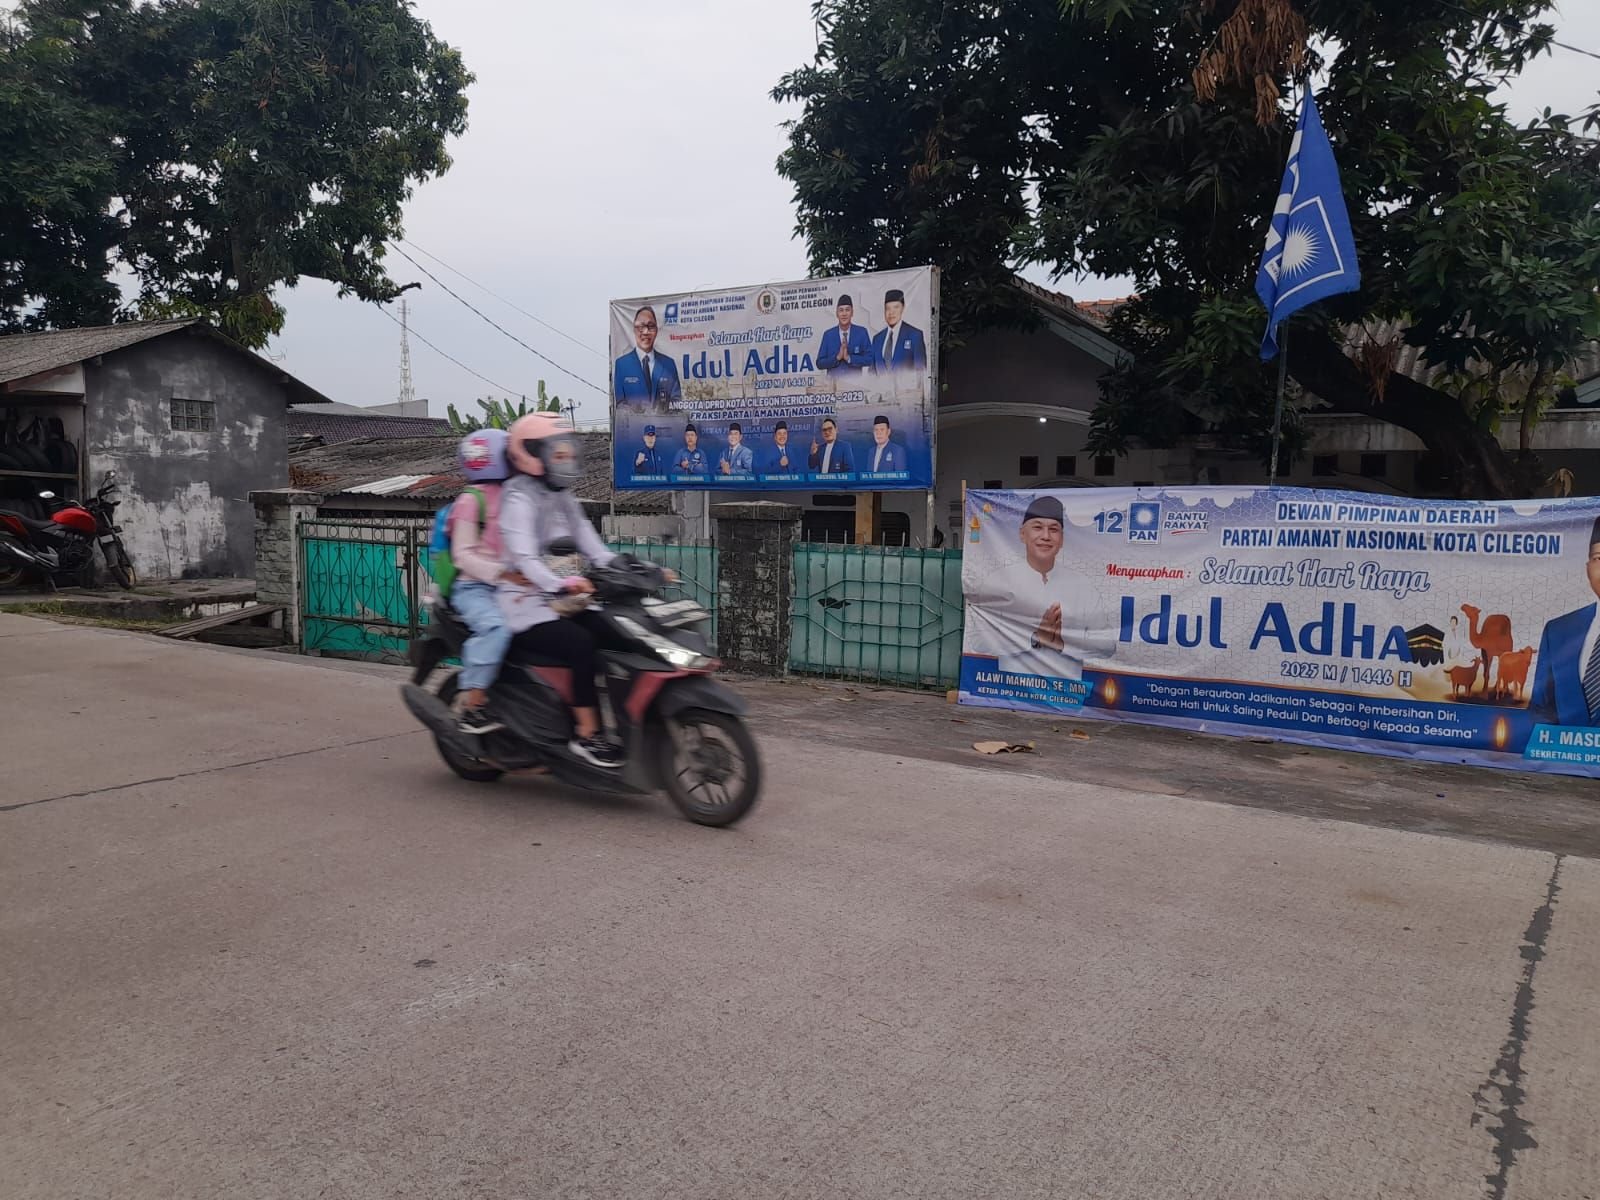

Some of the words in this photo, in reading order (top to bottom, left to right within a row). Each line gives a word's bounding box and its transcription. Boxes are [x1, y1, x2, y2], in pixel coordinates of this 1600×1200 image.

[719, 303, 746, 312] NASIONAL
[780, 301, 800, 312] KOTA
[801, 298, 834, 309] CILEGON
[693, 314, 716, 323] CILEGON
[708, 329, 750, 347] Selamat
[752, 325, 780, 343] Hari
[781, 324, 814, 343] Raya
[682, 349, 734, 380] Idul
[668, 400, 704, 411] ANGGOTA
[704, 399, 726, 410] DPRD
[726, 398, 746, 409] KOTA
[747, 396, 781, 408] CILEGON
[781, 395, 815, 407] PERIODE
[815, 394, 837, 404] 2024
[842, 391, 864, 403] 2029
[690, 410, 721, 420] FRAKSI
[722, 409, 753, 419] PARTAI
[754, 408, 791, 418] AMANAT
[791, 405, 836, 417] NASIONAL
[1094, 510, 1124, 534] 12
[1167, 512, 1207, 521] BANTU
[1278, 503, 1333, 521] DEWAN
[1337, 506, 1421, 523] PIMPINAN
[1426, 510, 1496, 524] DAERAH
[1129, 530, 1158, 541] PAN
[1164, 521, 1209, 530] RAKYAT
[1222, 529, 1273, 547] PARTAI
[1276, 529, 1341, 548] AMANAT
[1345, 530, 1427, 551] NASIONAL
[1433, 532, 1477, 552] KOTA
[1483, 533, 1561, 555] CILEGON
[1106, 563, 1184, 581] Mengucapkan
[1199, 556, 1294, 586] Selamat
[1297, 558, 1355, 589] Hari
[1359, 561, 1431, 600] Raya
[1119, 594, 1227, 649] Idul
[975, 671, 1004, 684] ALAWI
[1006, 675, 1050, 691] MAHMUD,
[1069, 682, 1087, 695] MM
[1280, 661, 1320, 678] 2025
[1322, 663, 1337, 680] M
[1351, 667, 1393, 686] 1446
[1397, 670, 1413, 687] H
[977, 687, 999, 695] KETUA
[1000, 689, 1014, 697] DPD
[1015, 690, 1029, 698] PAN
[1030, 692, 1047, 700] KOTA
[1049, 695, 1079, 705] CILEGON
[1146, 683, 1191, 697] "Dengan
[1193, 688, 1246, 701] Berqurban
[1308, 698, 1356, 714] Sebagai
[1358, 704, 1434, 720] Pembersihan
[1437, 709, 1460, 723] Diri,
[1132, 695, 1178, 708] Pembuka
[1181, 700, 1200, 710] Hati
[1202, 702, 1231, 714] Untuk
[1233, 706, 1264, 719] Saling
[1267, 709, 1299, 721] Peduli
[1302, 712, 1324, 724] Dan
[1327, 715, 1371, 731] Berbagi
[1373, 720, 1421, 735] Kepada
[1423, 726, 1478, 740] Sesama"
[1539, 730, 1554, 744] H.
[1530, 749, 1582, 761] SEKRETARIS
